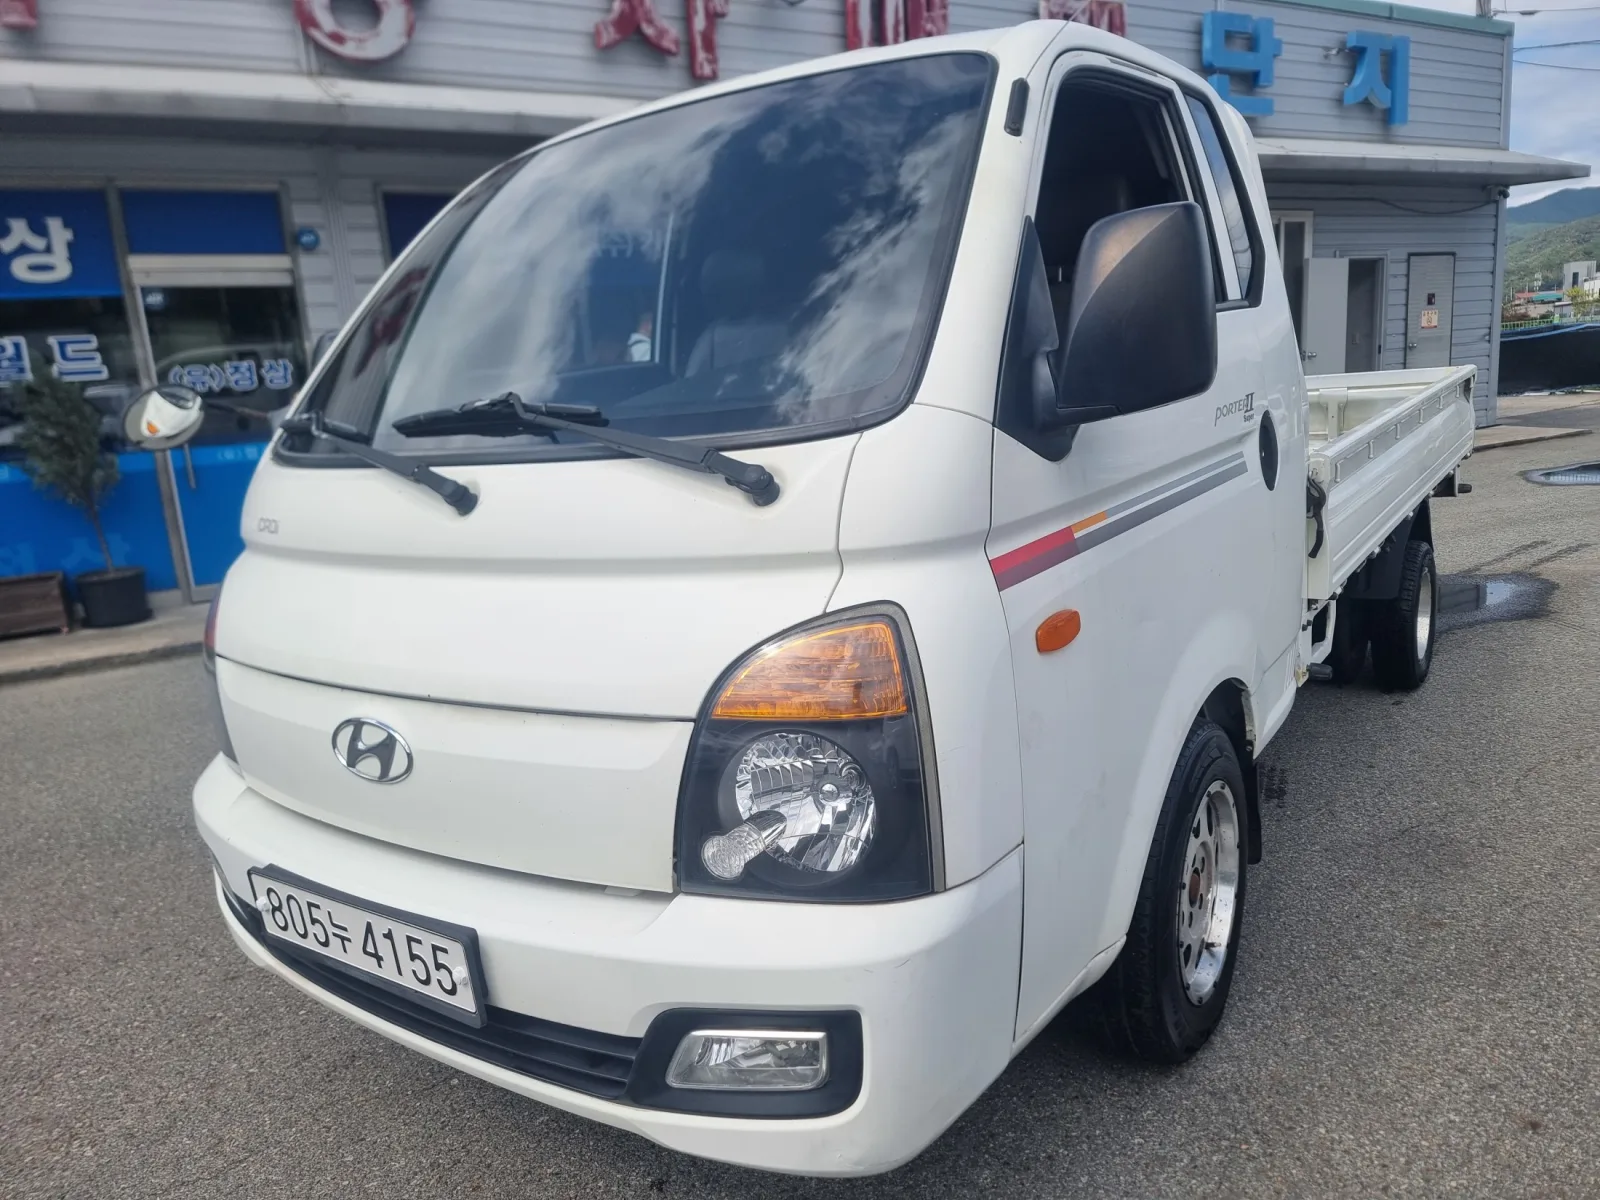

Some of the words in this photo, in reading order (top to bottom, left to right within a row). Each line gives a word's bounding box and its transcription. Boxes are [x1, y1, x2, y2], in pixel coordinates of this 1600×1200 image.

[1203, 10, 1411, 126] 단지
[0, 216, 74, 284] 상
[168, 358, 293, 393] (유)정상
[266, 887, 352, 954] 805누
[362, 920, 458, 996] 4155
